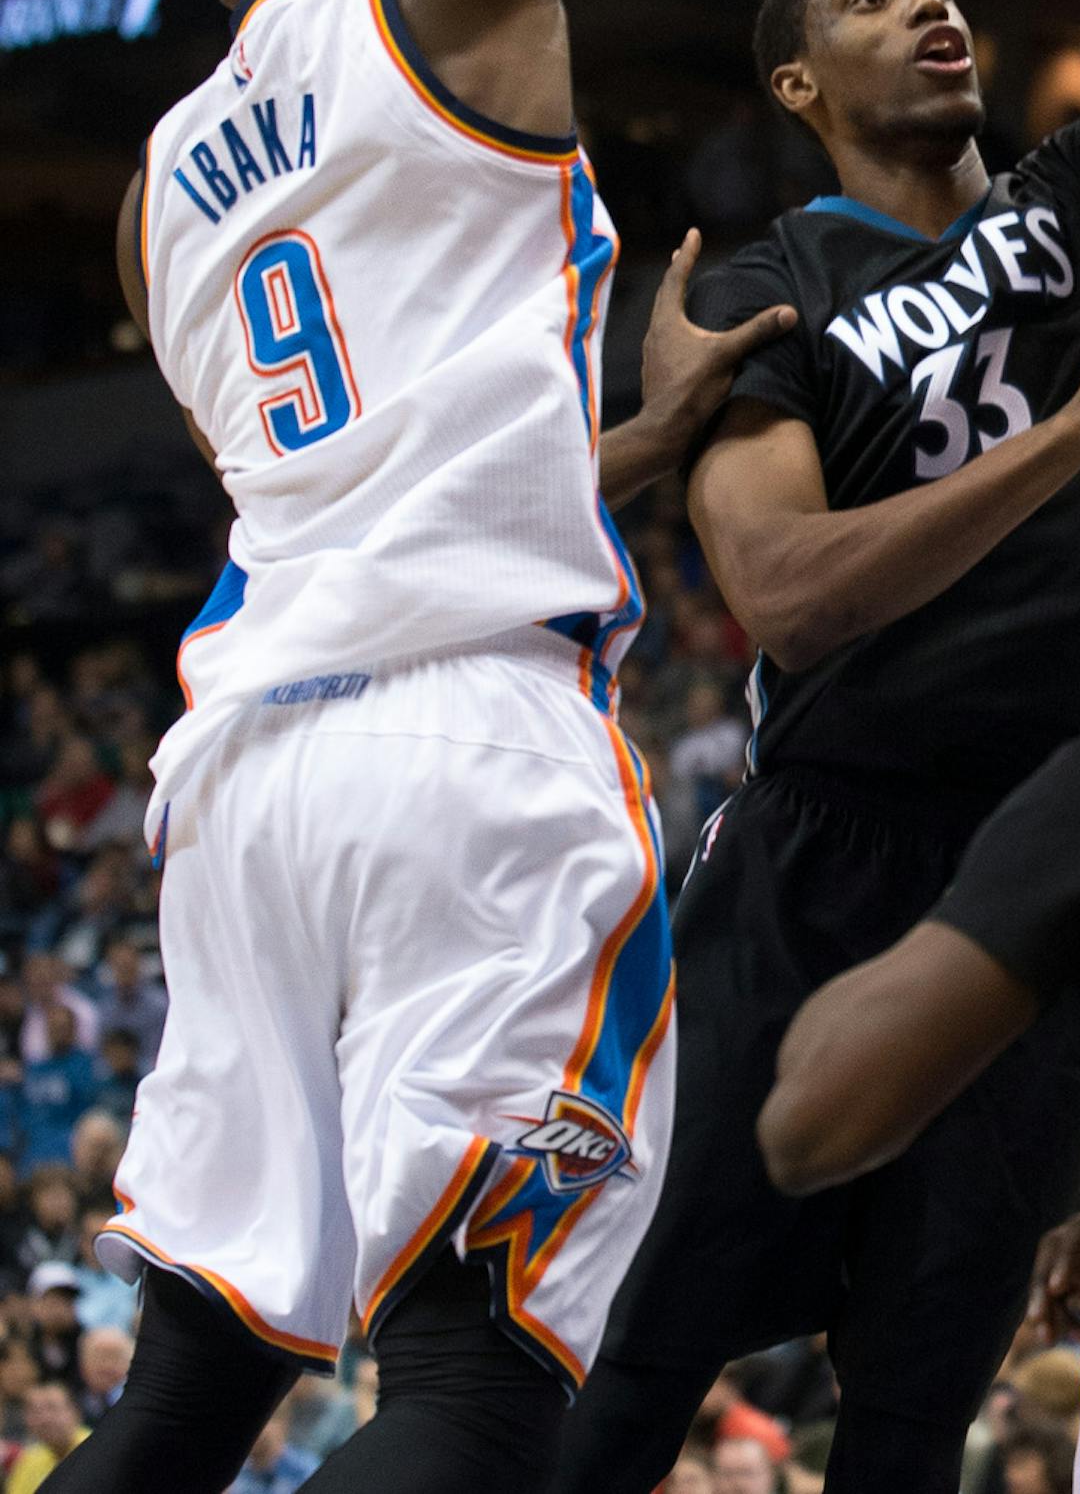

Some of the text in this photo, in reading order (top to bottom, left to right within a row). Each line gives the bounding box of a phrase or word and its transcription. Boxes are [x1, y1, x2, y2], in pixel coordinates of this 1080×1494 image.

[173, 93, 317, 225] IBAKA
[234, 227, 362, 458] 9
[825, 206, 1075, 388] WOLVES
[911, 326, 1033, 480] 33
[519, 1119, 617, 1161] OKC
